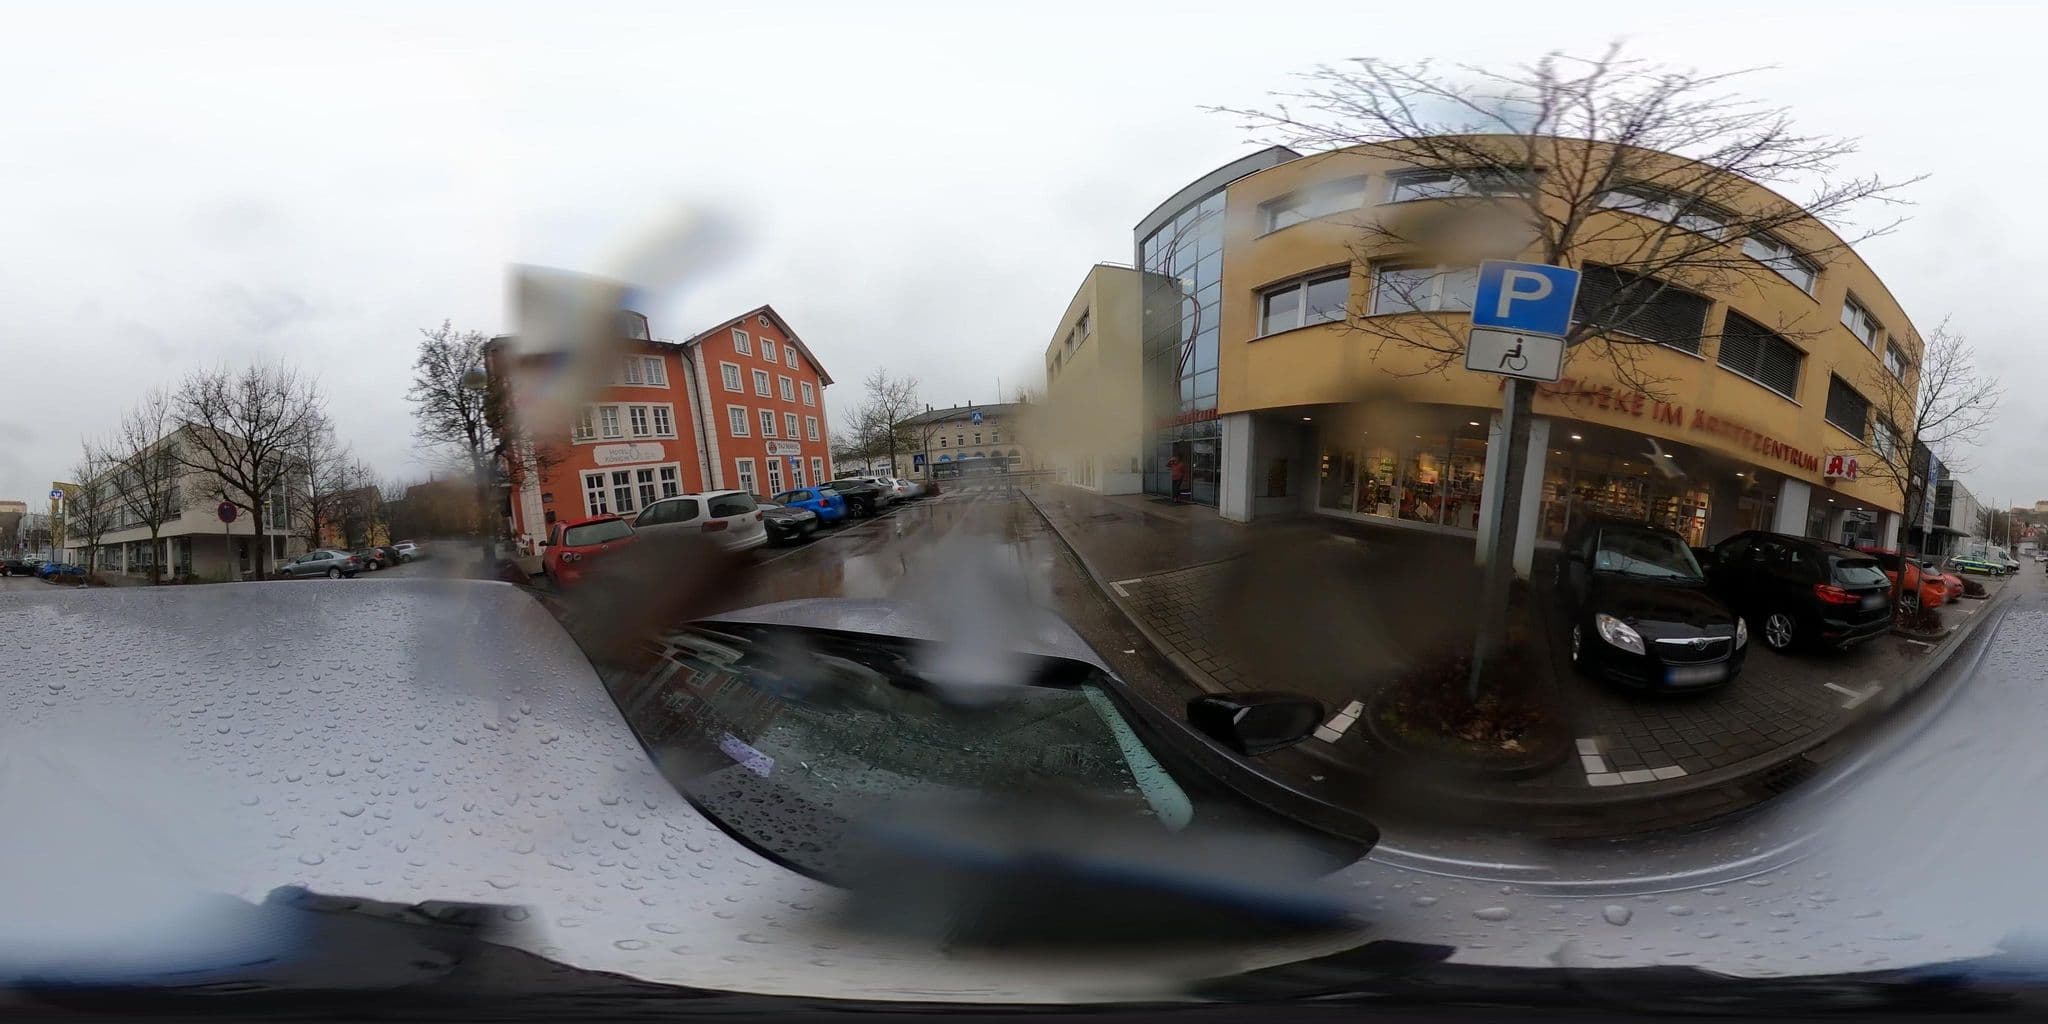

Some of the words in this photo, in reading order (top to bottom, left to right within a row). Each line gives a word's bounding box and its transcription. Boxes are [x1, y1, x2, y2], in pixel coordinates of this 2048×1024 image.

[1496, 269, 1553, 318] P
[1652, 401, 1683, 427] IM
[1827, 455, 1843, 475] A
